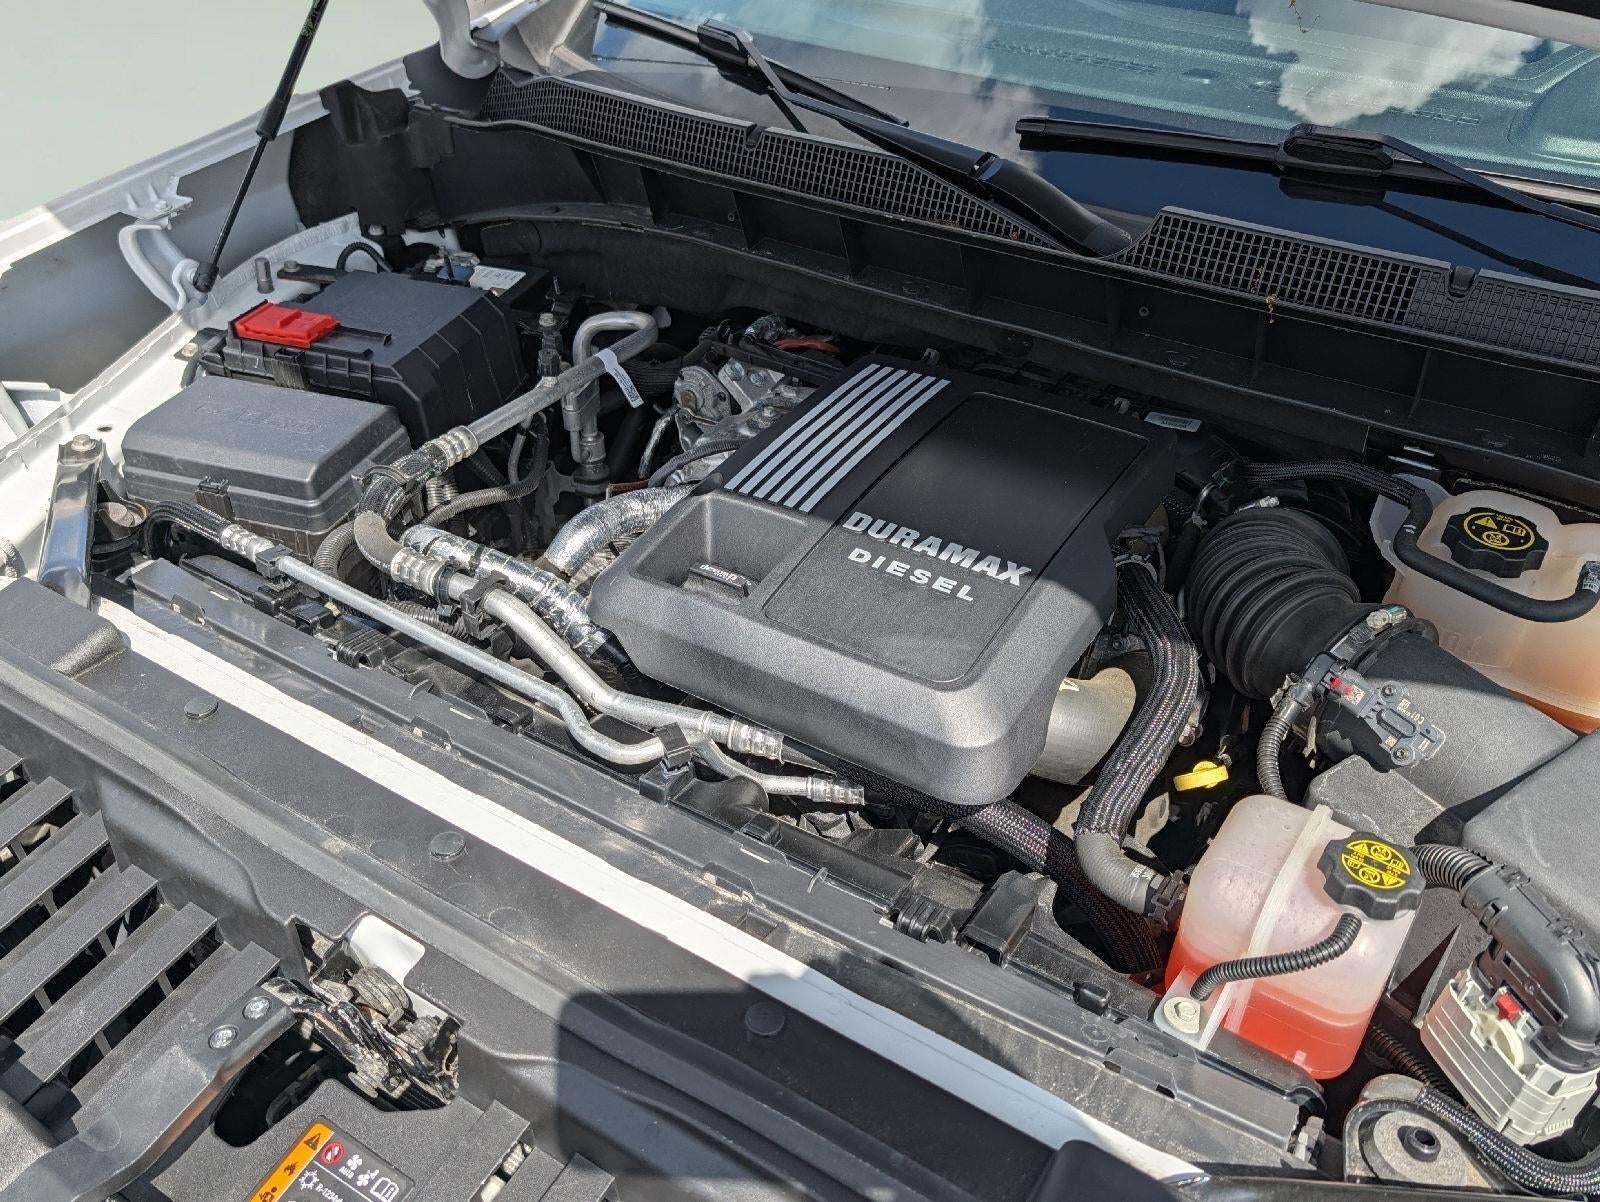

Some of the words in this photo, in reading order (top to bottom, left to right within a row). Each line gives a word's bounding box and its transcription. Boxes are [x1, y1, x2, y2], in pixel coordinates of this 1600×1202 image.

[843, 511, 1031, 586] DURAMAX
[848, 548, 973, 601] DIESEL
[339, 1166, 355, 1179] AUTO
